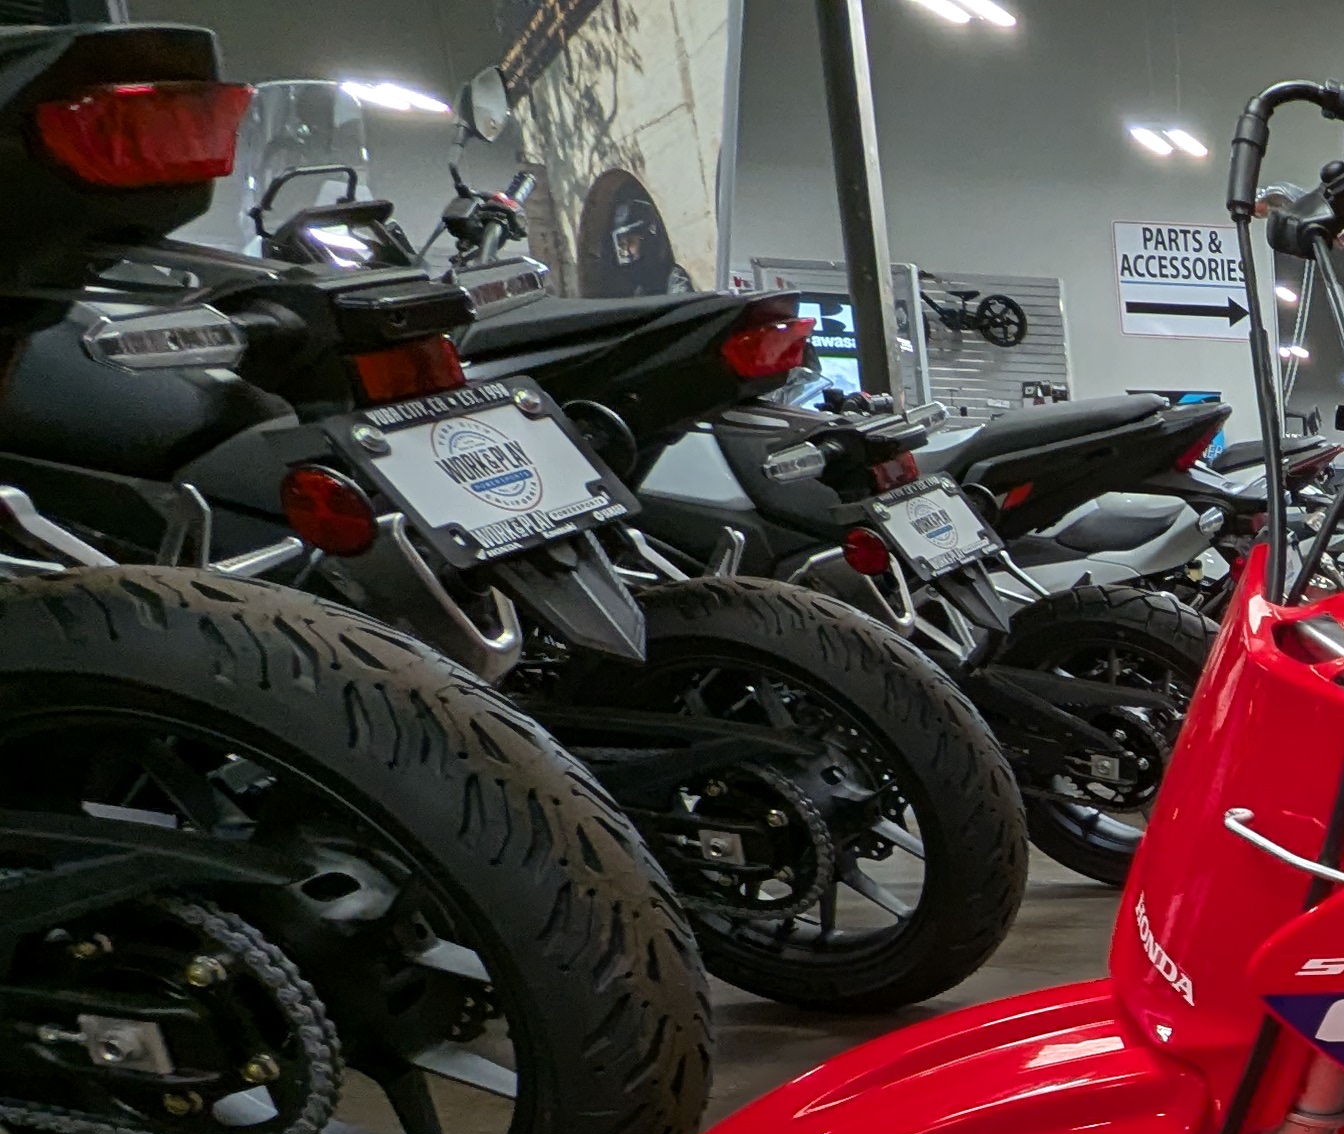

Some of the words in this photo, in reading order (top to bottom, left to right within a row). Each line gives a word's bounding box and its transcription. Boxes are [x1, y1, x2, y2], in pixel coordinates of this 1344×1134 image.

[1141, 227, 1203, 253] PARTS
[1208, 230, 1222, 254] &
[1134, 890, 1195, 1007] HONDA
